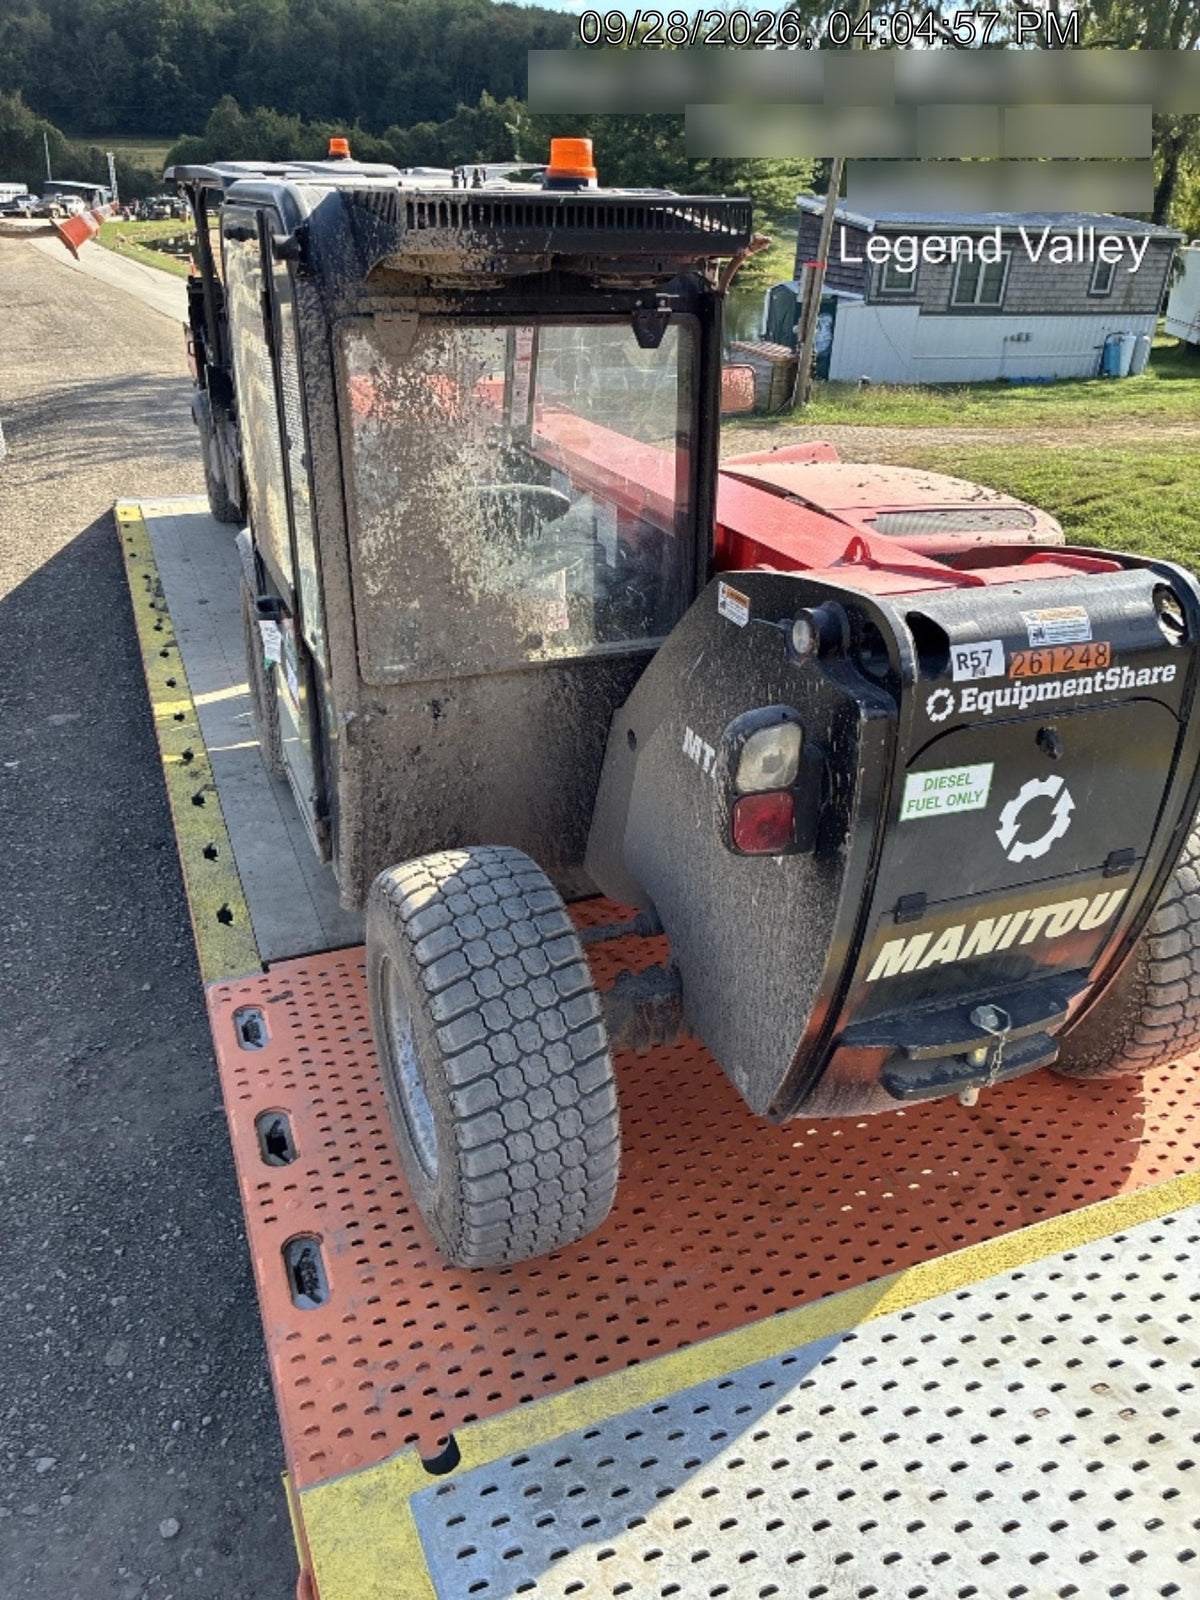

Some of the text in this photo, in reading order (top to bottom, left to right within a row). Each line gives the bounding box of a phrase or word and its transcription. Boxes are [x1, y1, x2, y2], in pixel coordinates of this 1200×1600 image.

[956, 649, 993, 671] R57
[1012, 643, 1108, 676] 261248
[958, 664, 1177, 715] EquipmentShare
[682, 726, 717, 779] MT
[923, 773, 973, 792] DIESEL
[906, 789, 984, 813] FUEL ONLY
[865, 888, 1128, 982] MANITOU
